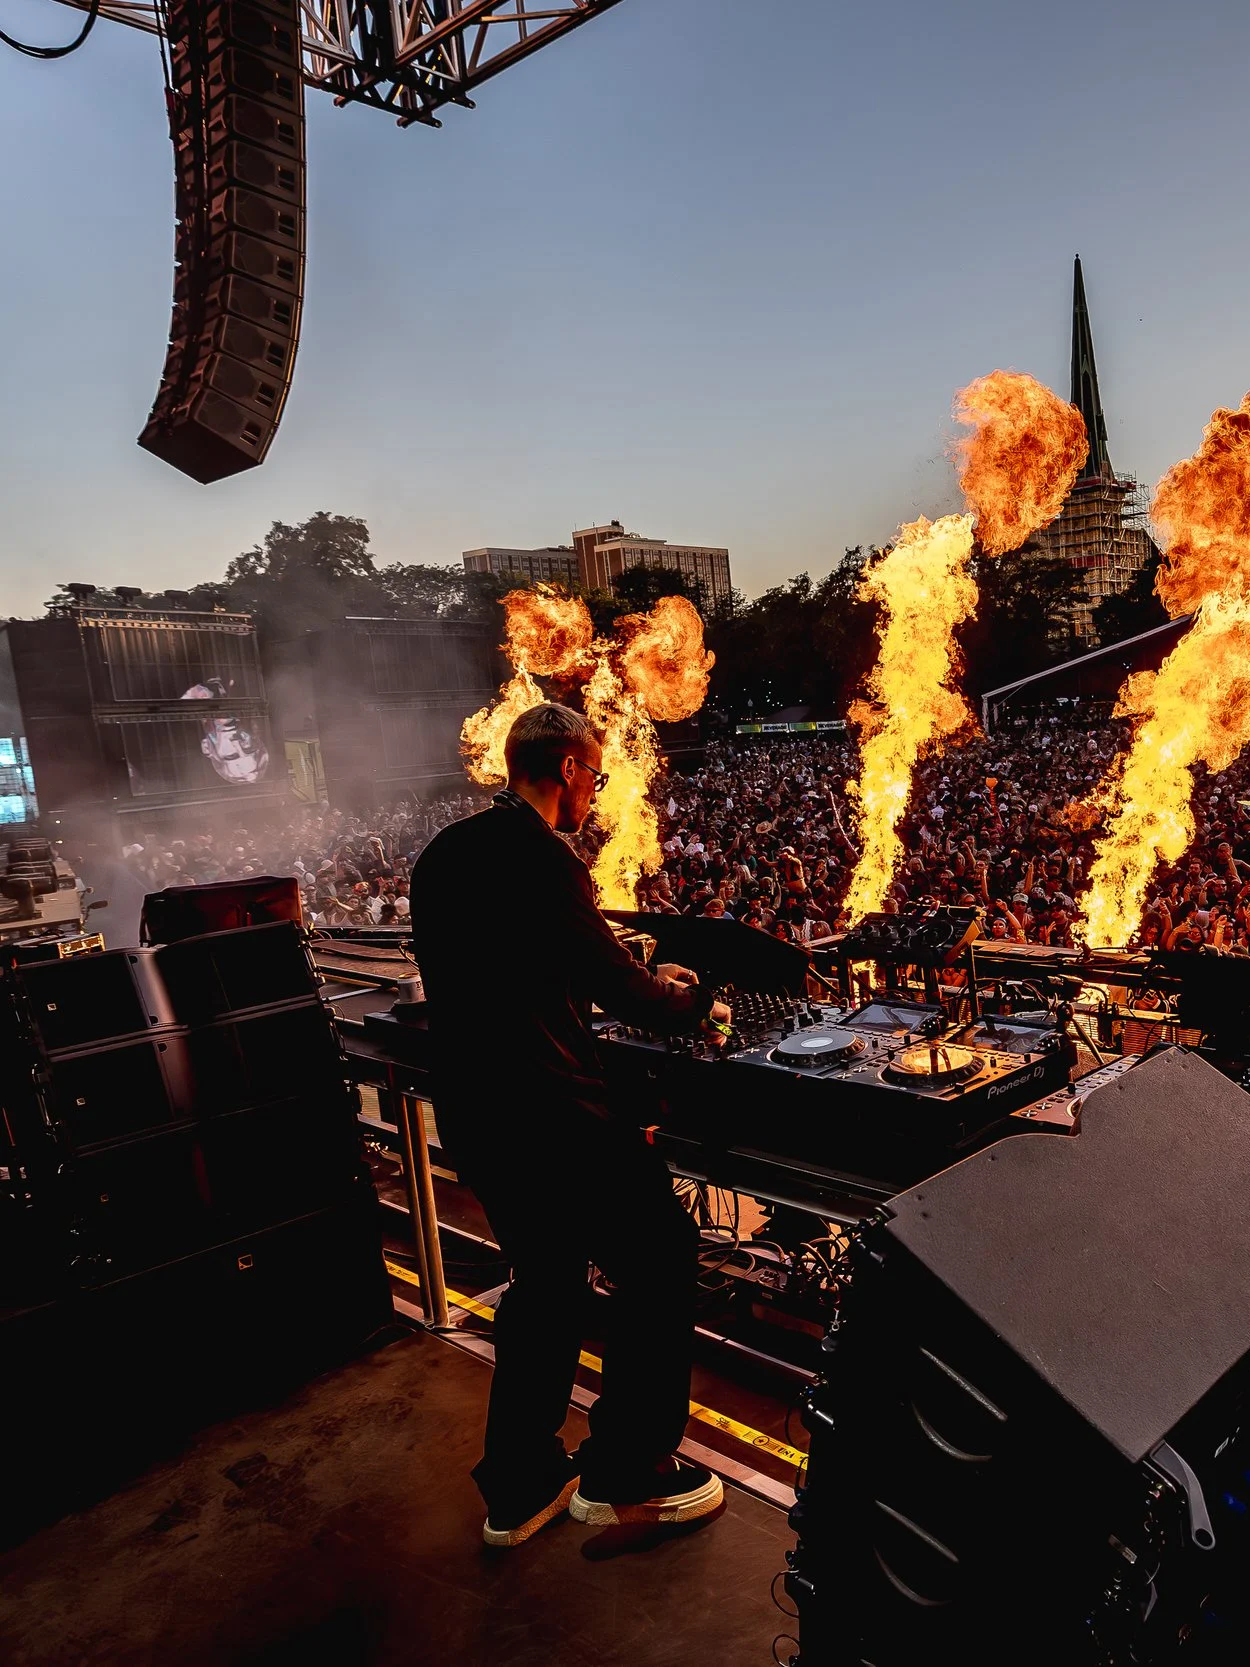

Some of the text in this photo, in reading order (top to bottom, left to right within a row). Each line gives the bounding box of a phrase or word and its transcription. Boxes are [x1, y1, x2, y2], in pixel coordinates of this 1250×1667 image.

[987, 1066, 1045, 1100] Pioneer DJ
[777, 1446, 796, 1459] USA
